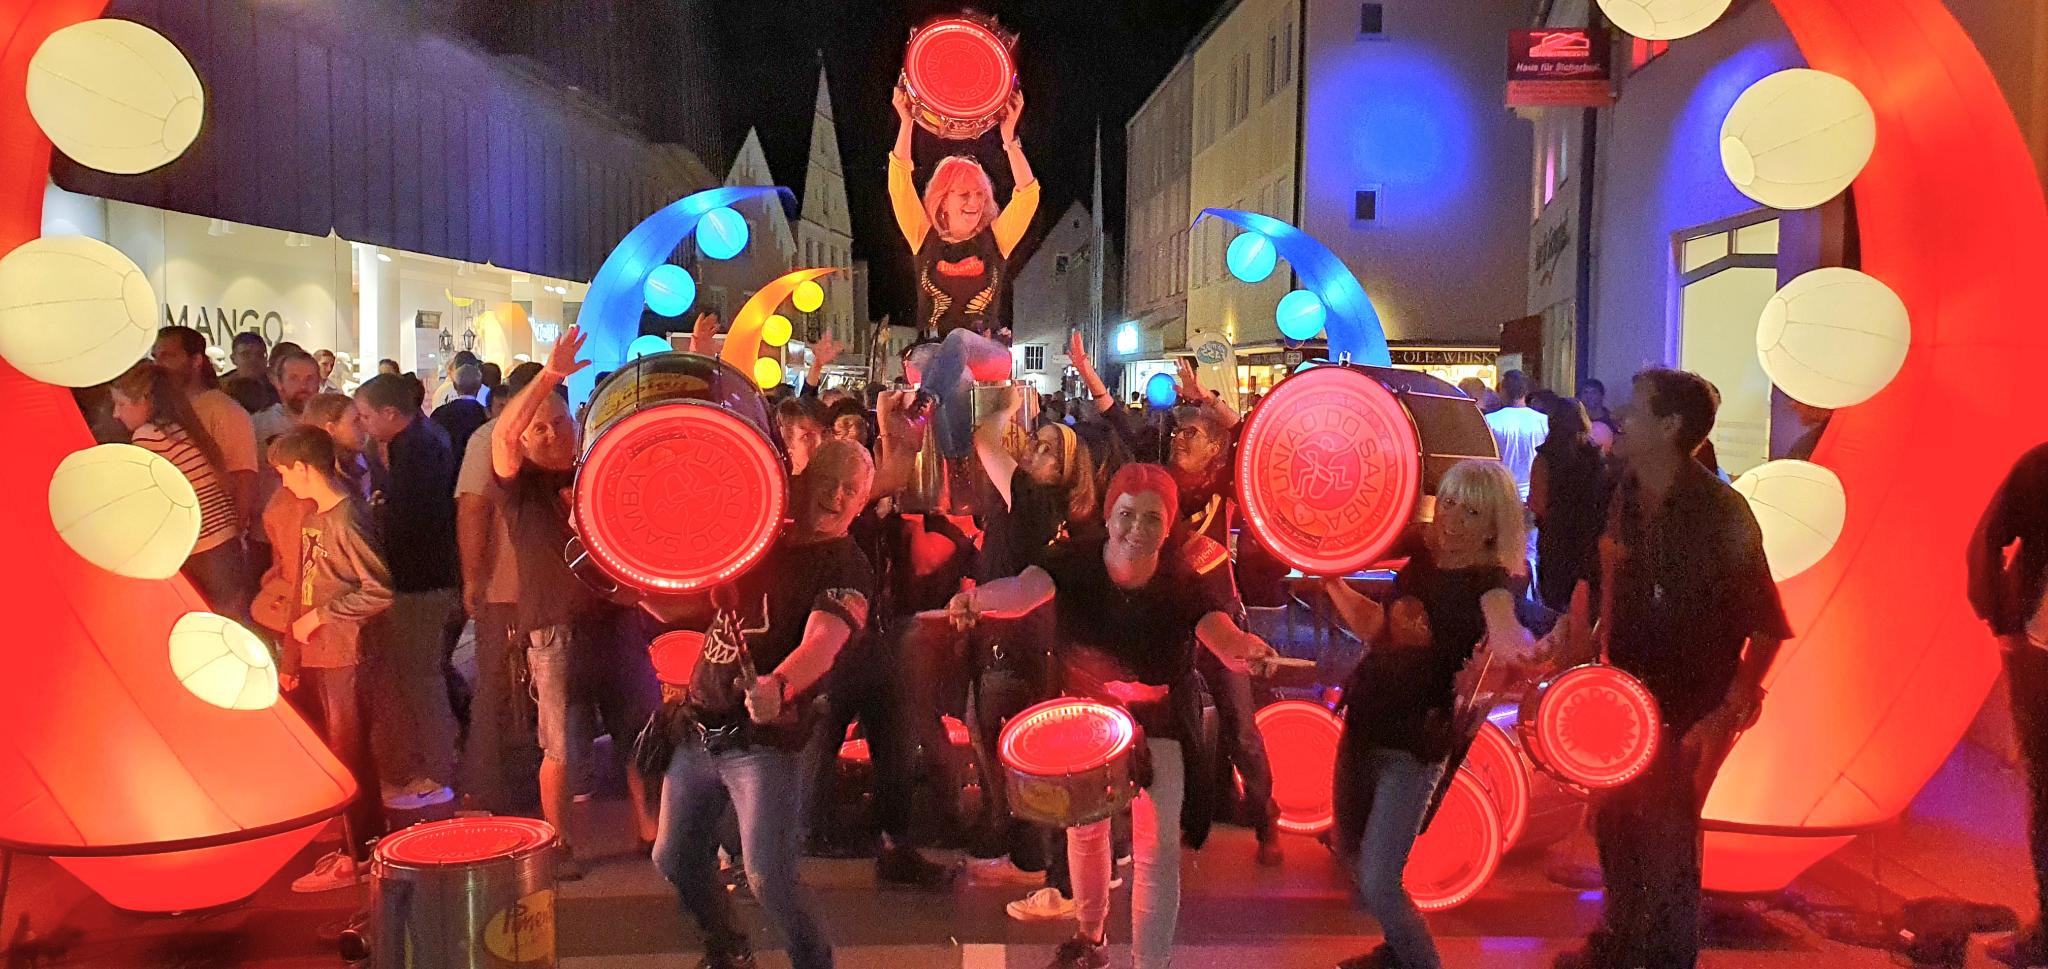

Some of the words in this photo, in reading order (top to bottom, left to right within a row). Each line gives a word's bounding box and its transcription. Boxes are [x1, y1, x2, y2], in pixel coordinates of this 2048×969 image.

[1516, 62, 1539, 72] Haus
[1540, 61, 1554, 72] für
[161, 303, 284, 348] MANGO
[1403, 351, 1435, 363] OLE
